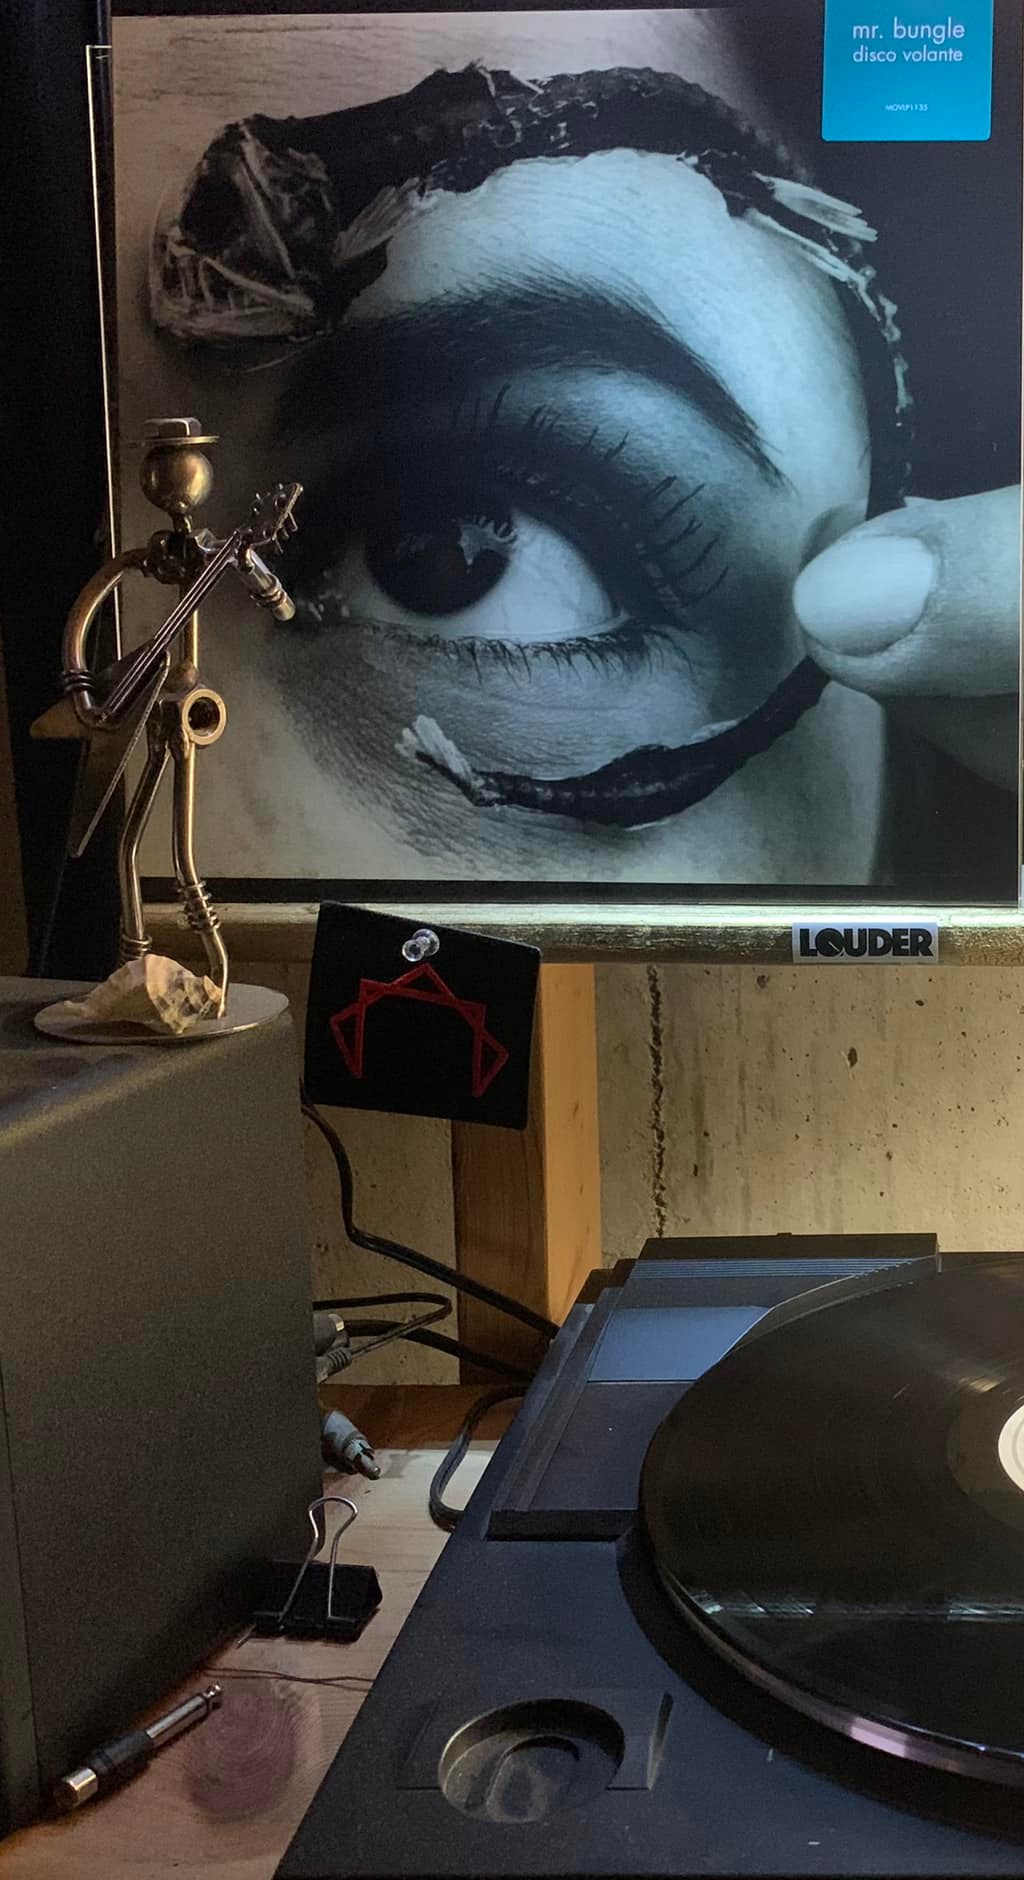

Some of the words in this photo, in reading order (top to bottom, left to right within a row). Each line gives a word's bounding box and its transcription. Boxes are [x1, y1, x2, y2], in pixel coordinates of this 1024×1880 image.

[852, 24, 883, 39] mr.
[893, 16, 965, 44] bungle
[852, 45, 897, 62] disco
[902, 45, 963, 62] volante
[799, 927, 934, 957] LOUDER
